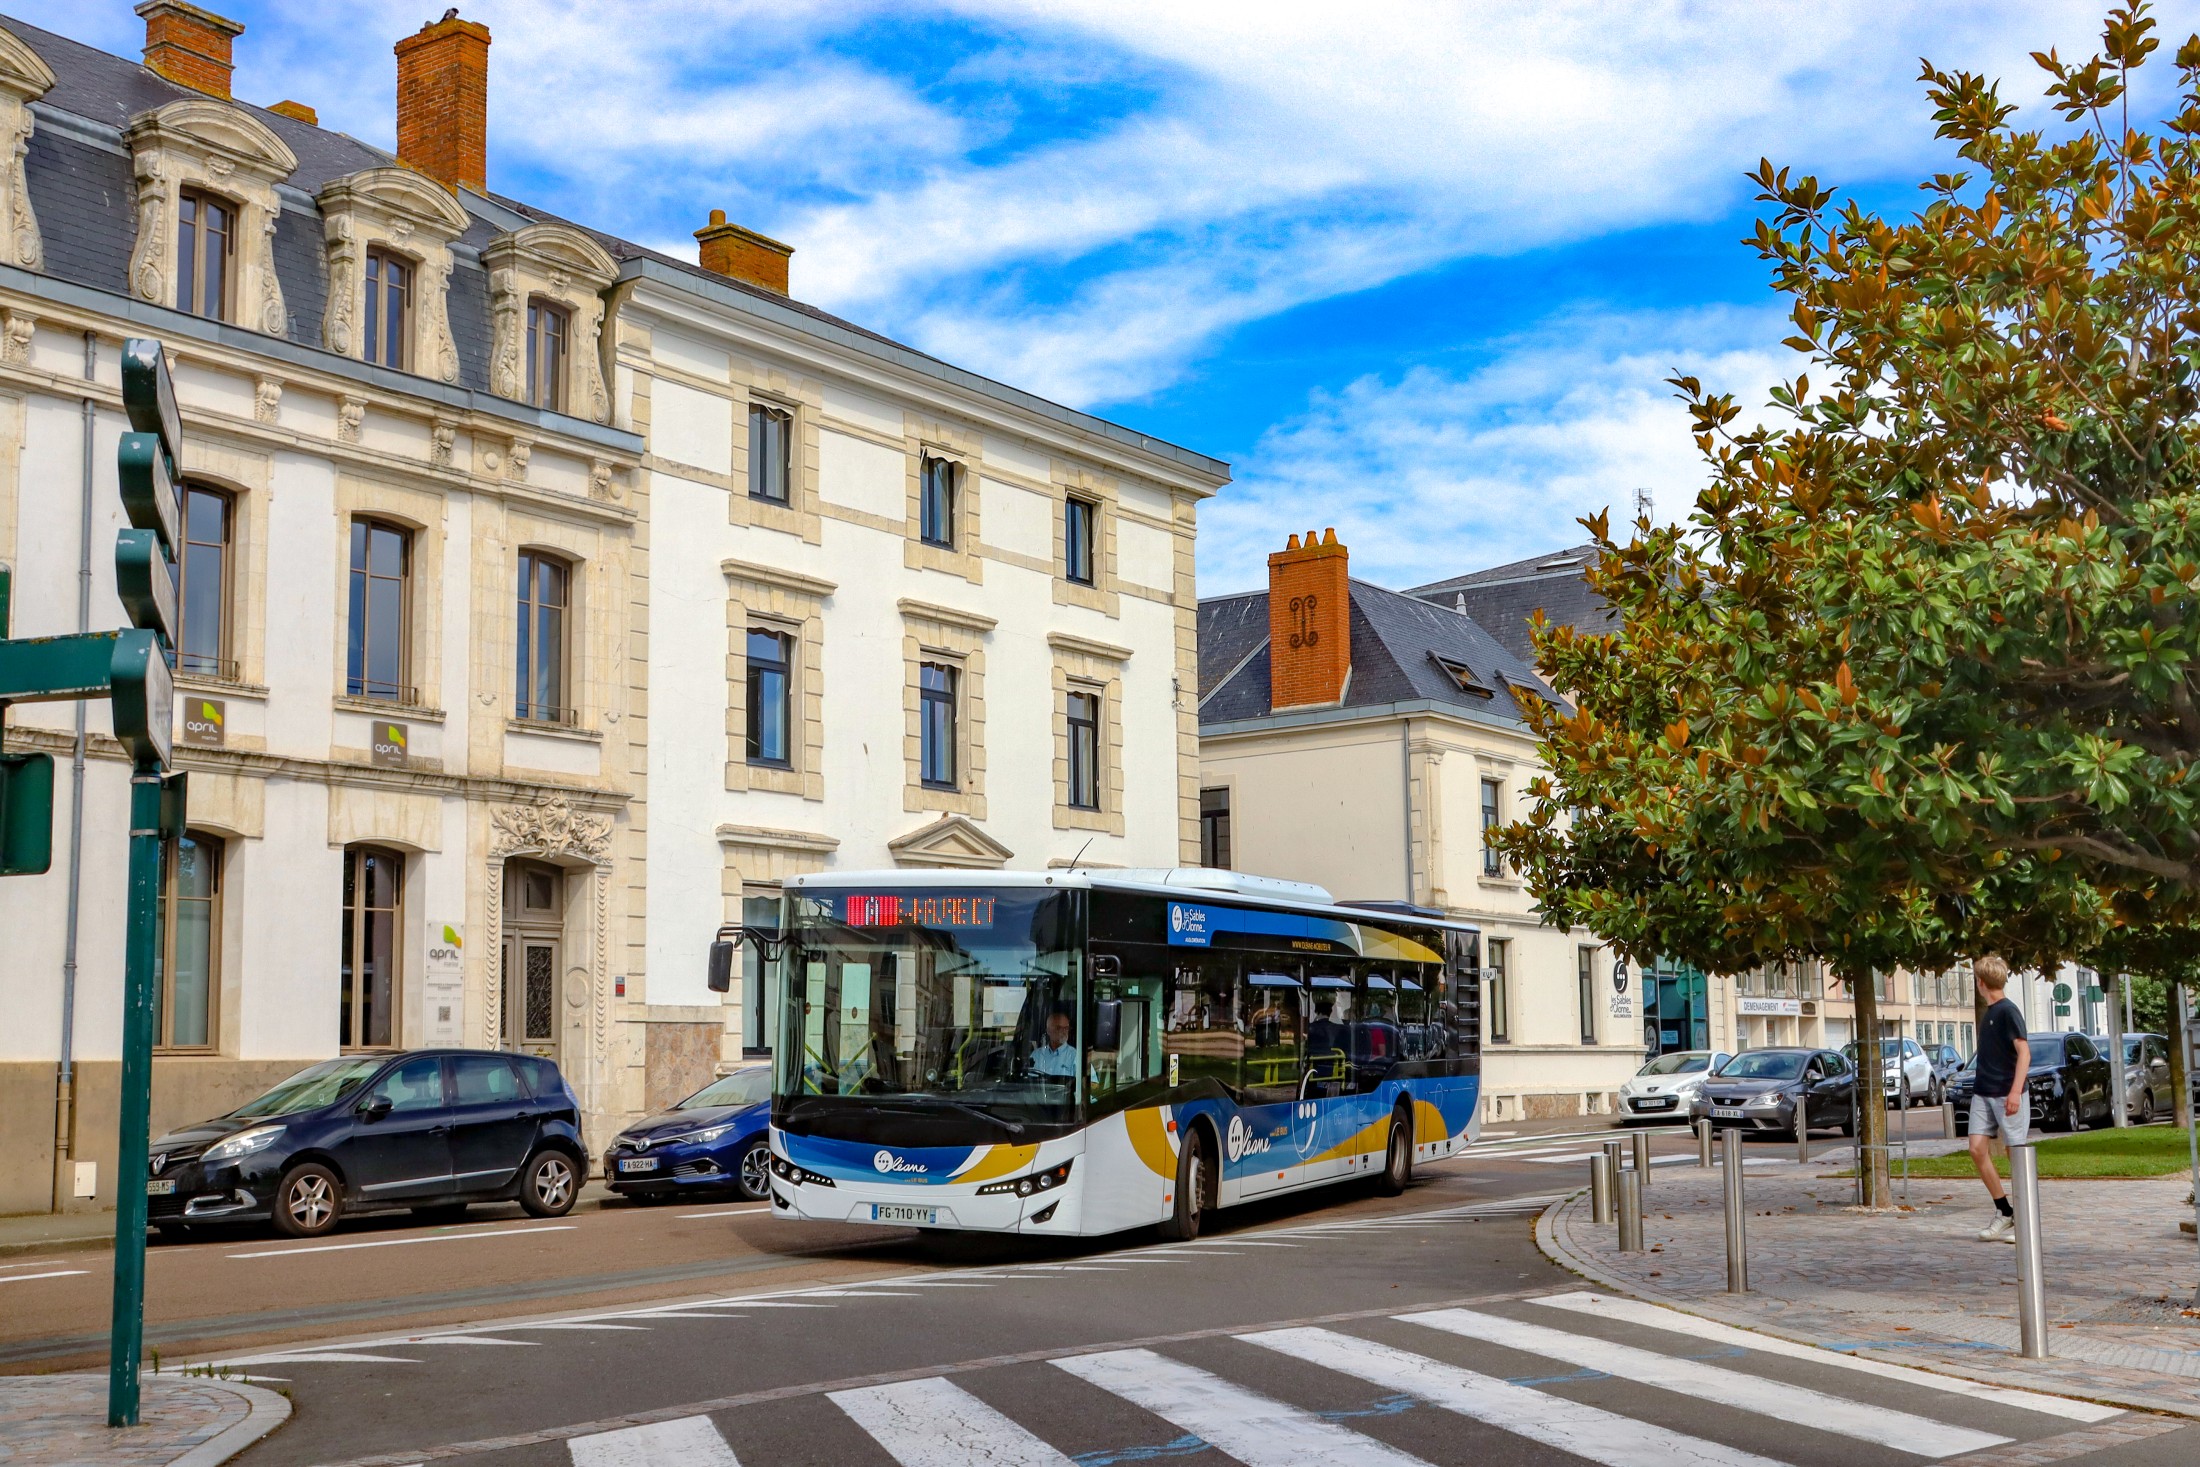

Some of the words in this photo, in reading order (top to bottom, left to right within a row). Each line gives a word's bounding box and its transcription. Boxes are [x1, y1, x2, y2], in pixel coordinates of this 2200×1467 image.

[186, 720, 218, 734] april
[375, 742, 402, 755] april
[1190, 908, 1206, 922] Sables
[429, 948, 459, 962] april
[1743, 1001, 1779, 1012] DEMENAGEMENT
[879, 1206, 928, 1221] FG-710-YY
